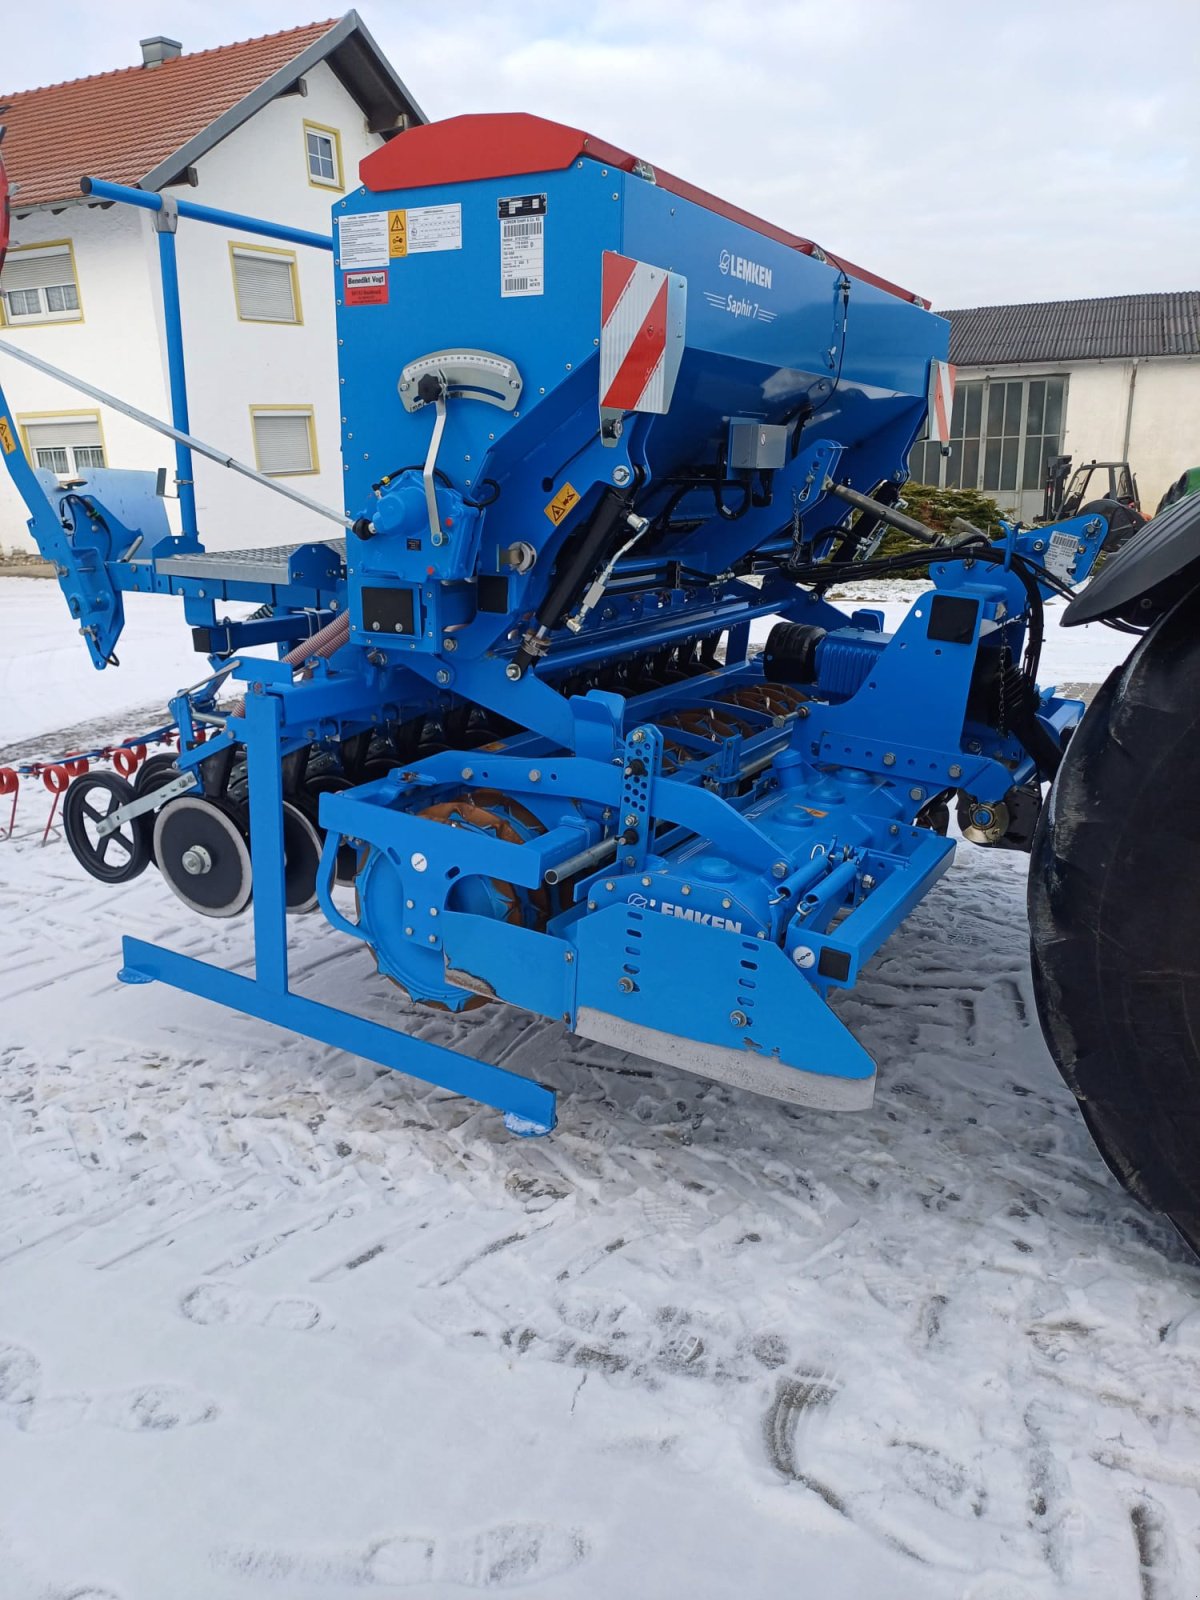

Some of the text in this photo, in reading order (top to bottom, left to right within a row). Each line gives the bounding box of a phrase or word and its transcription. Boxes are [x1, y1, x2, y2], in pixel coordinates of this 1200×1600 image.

[348, 276, 370, 284] Benedikt
[730, 254, 772, 289] LEMKEN
[726, 294, 759, 318] Saphir 7
